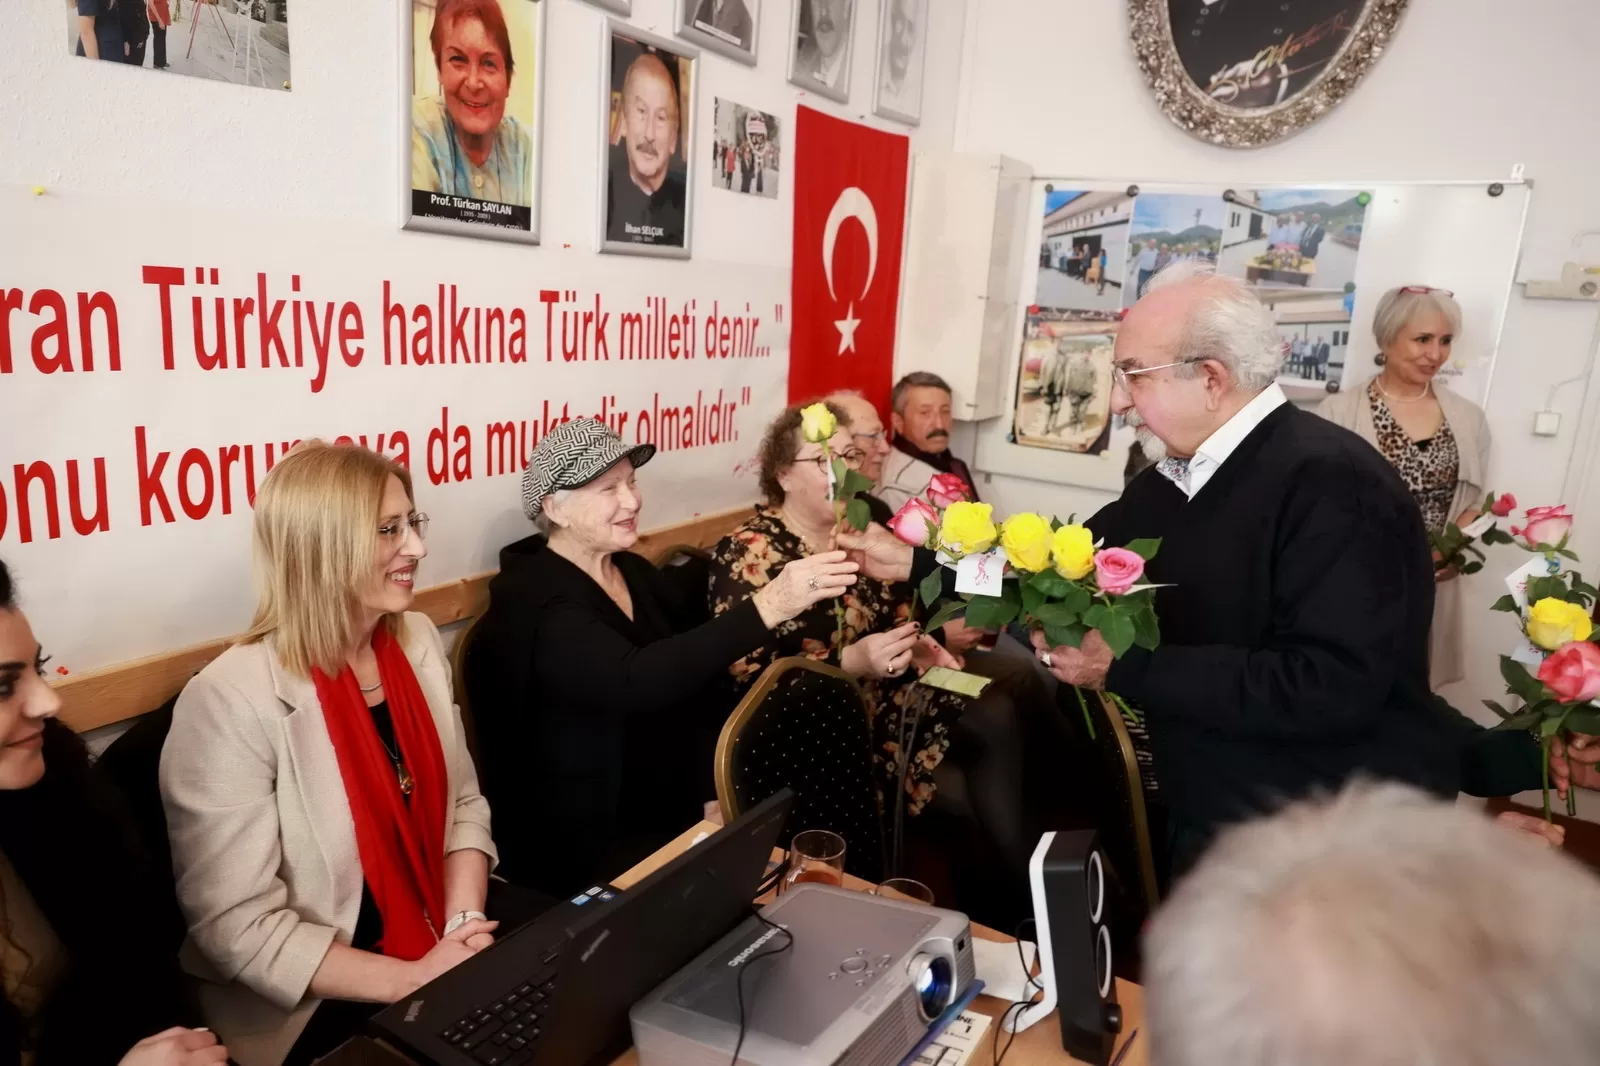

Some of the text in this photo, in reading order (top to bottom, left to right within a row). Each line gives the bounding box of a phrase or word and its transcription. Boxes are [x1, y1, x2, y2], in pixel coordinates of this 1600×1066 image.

[430, 194, 512, 215] Prof. Türkan SAYLAN
[142, 265, 365, 393] Türkiye
[383, 280, 527, 366] halkına
[539, 290, 609, 362] Türk
[620, 297, 696, 360] milleti
[0, 457, 110, 543] nu
[427, 407, 472, 486] da
